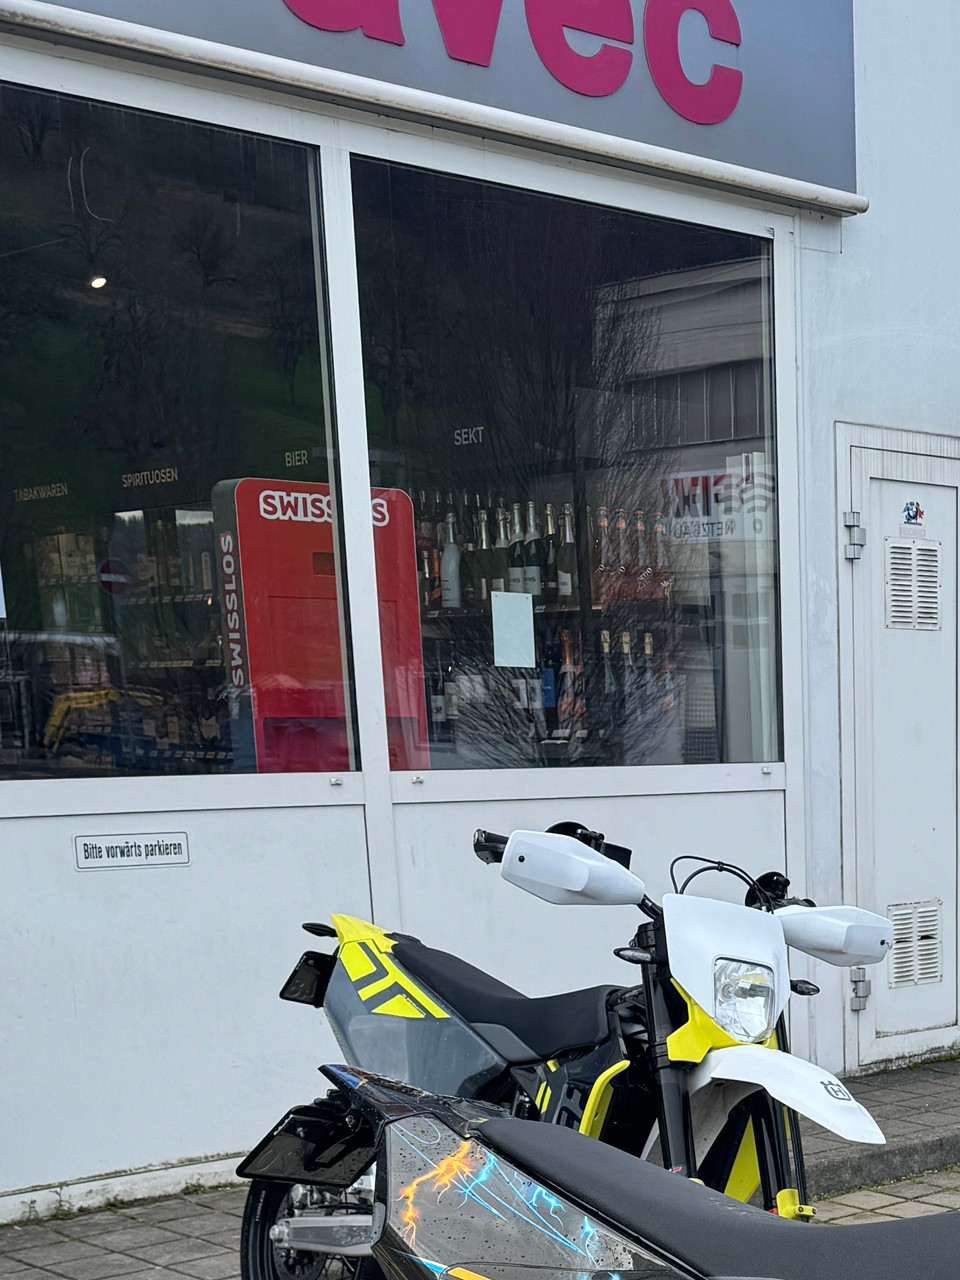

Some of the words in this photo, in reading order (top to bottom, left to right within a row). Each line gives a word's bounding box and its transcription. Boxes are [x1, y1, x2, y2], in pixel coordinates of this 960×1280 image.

[282, 0, 744, 125] ec
[454, 426, 484, 446] SEKT
[285, 450, 309, 467] BIER
[122, 468, 179, 487] SPIRITUOSEN
[14, 482, 68, 502] TABAKWAREN
[260, 491, 389, 527] SWISS
[221, 534, 244, 686] SWISSLOS
[83, 842, 103, 860] Bitte
[105, 841, 142, 859] vorwärts
[144, 840, 183, 860] parkieren
